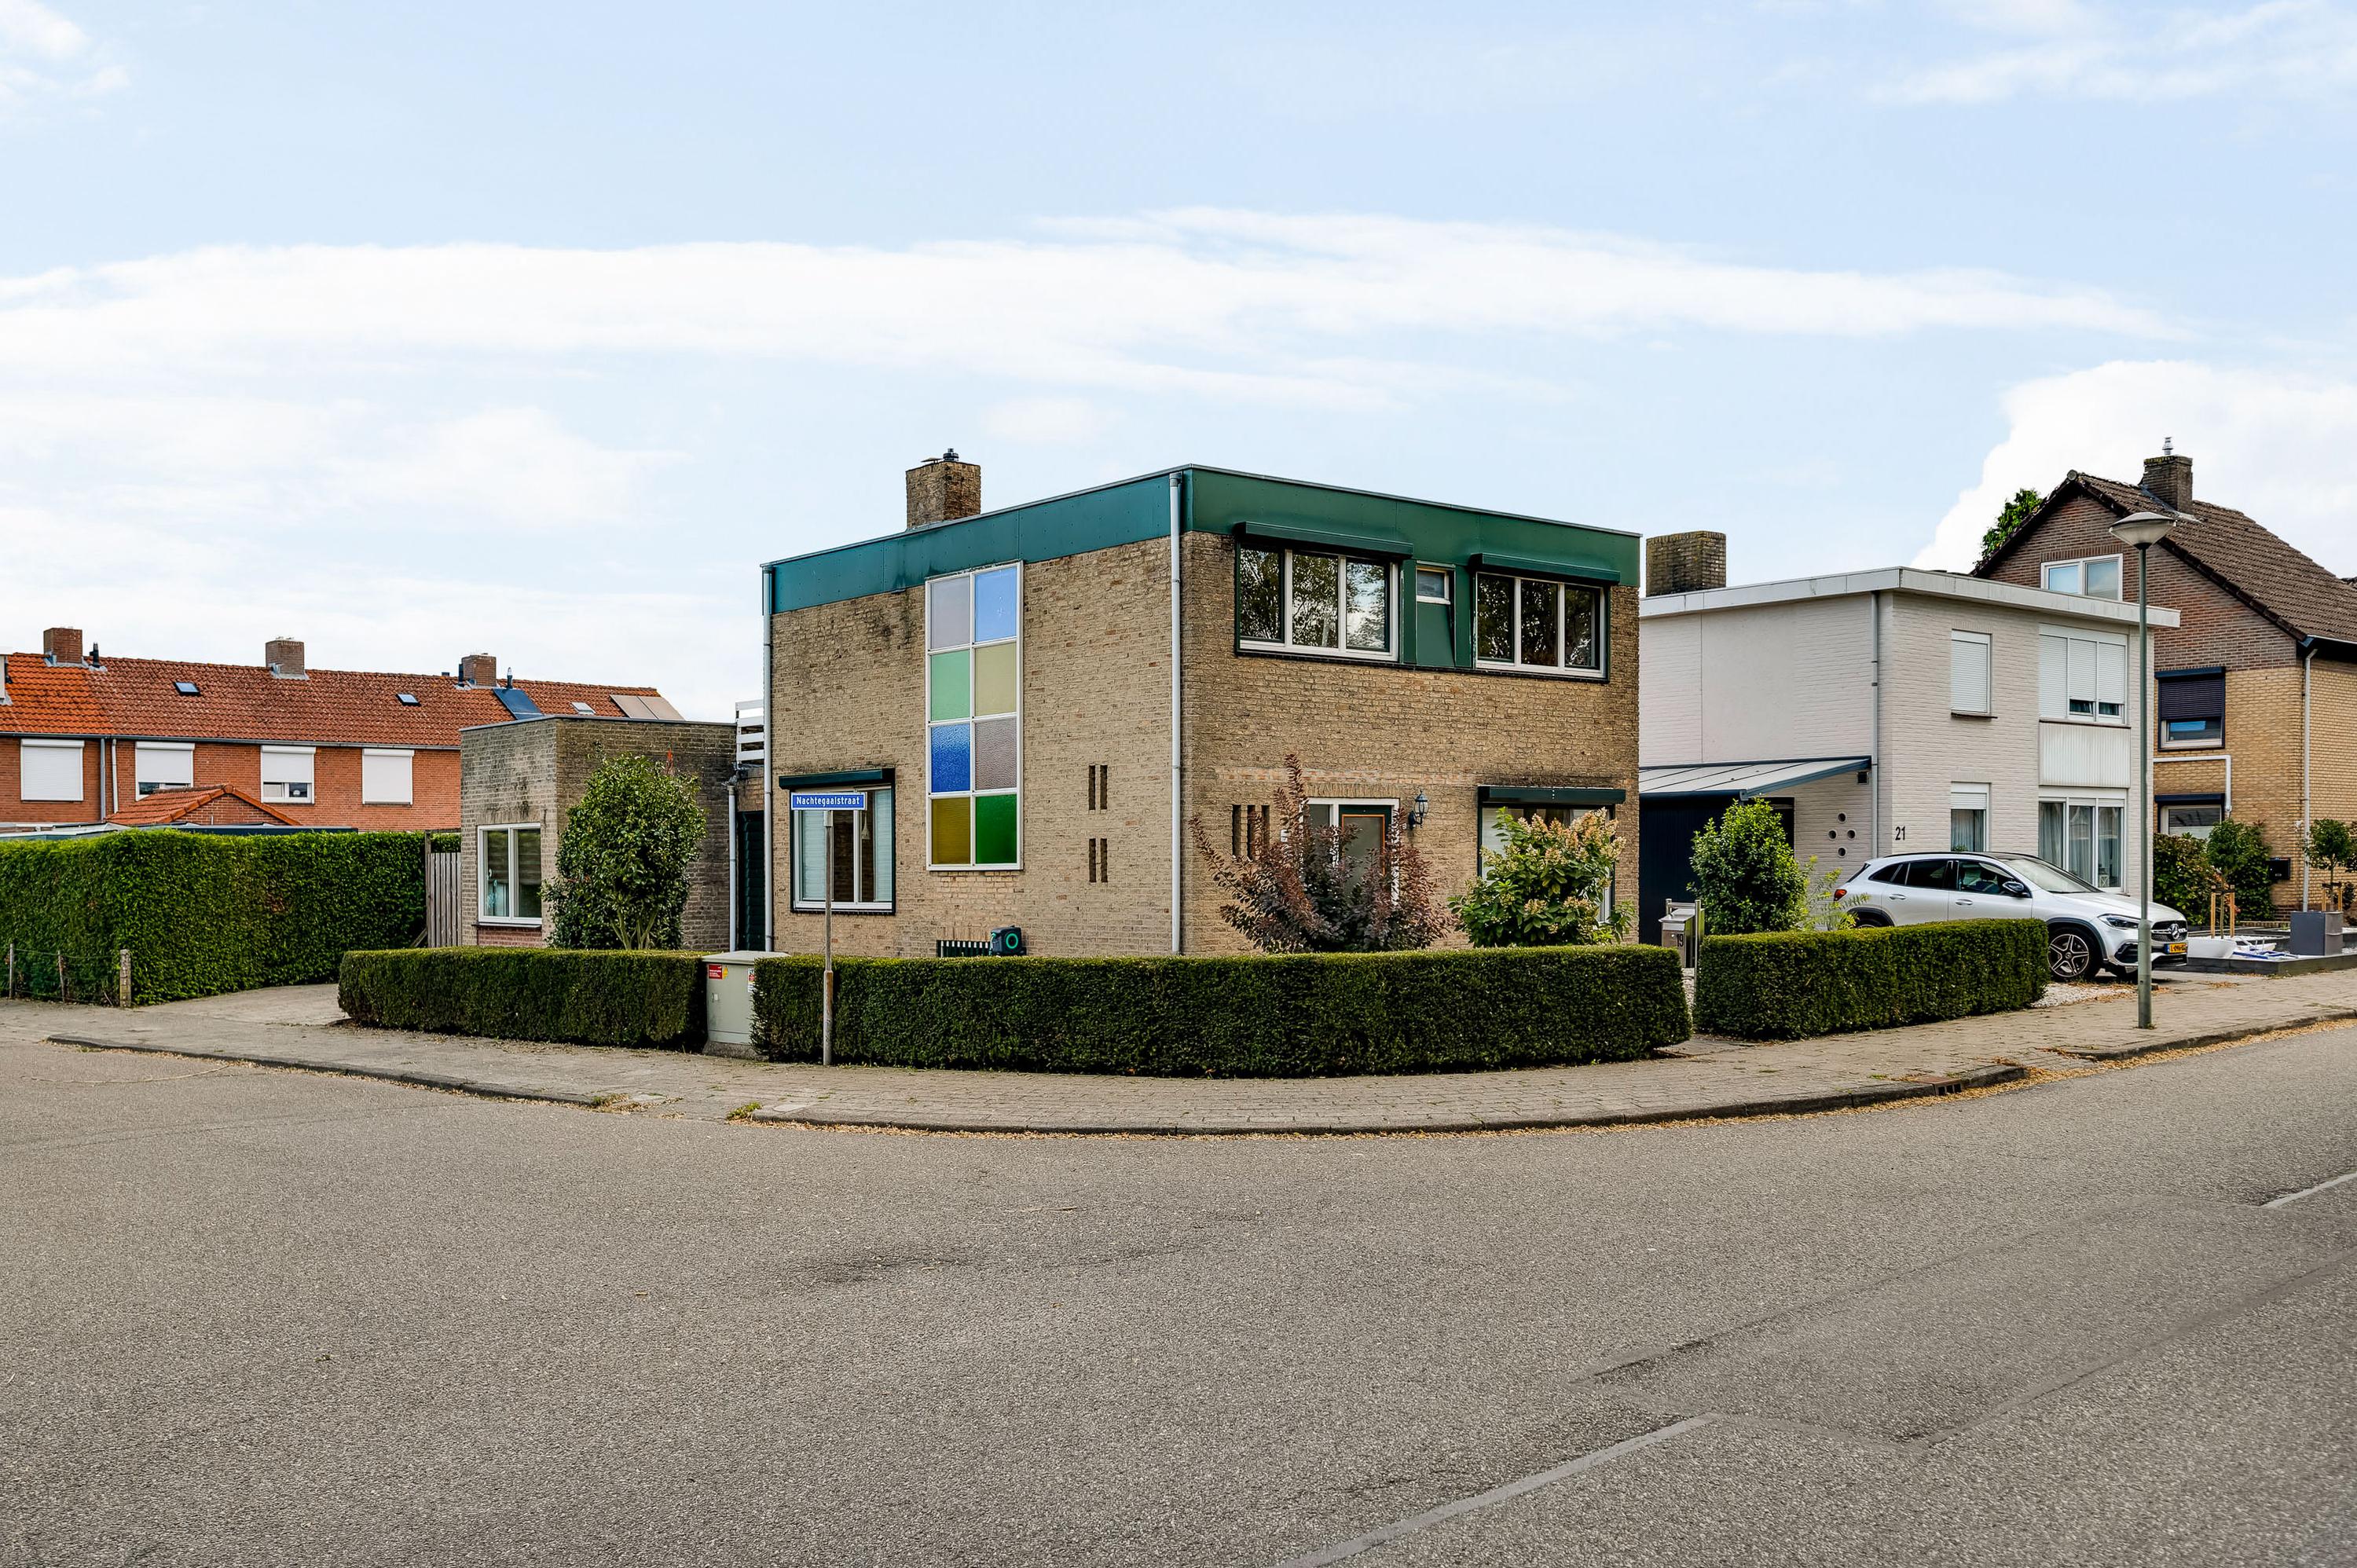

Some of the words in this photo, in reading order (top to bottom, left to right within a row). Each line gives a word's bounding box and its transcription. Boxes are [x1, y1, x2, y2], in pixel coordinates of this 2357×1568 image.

[796, 796, 860, 807] Nachtegaalstraat
[1895, 826, 1905, 841] 21
[1677, 933, 1684, 947] 19
